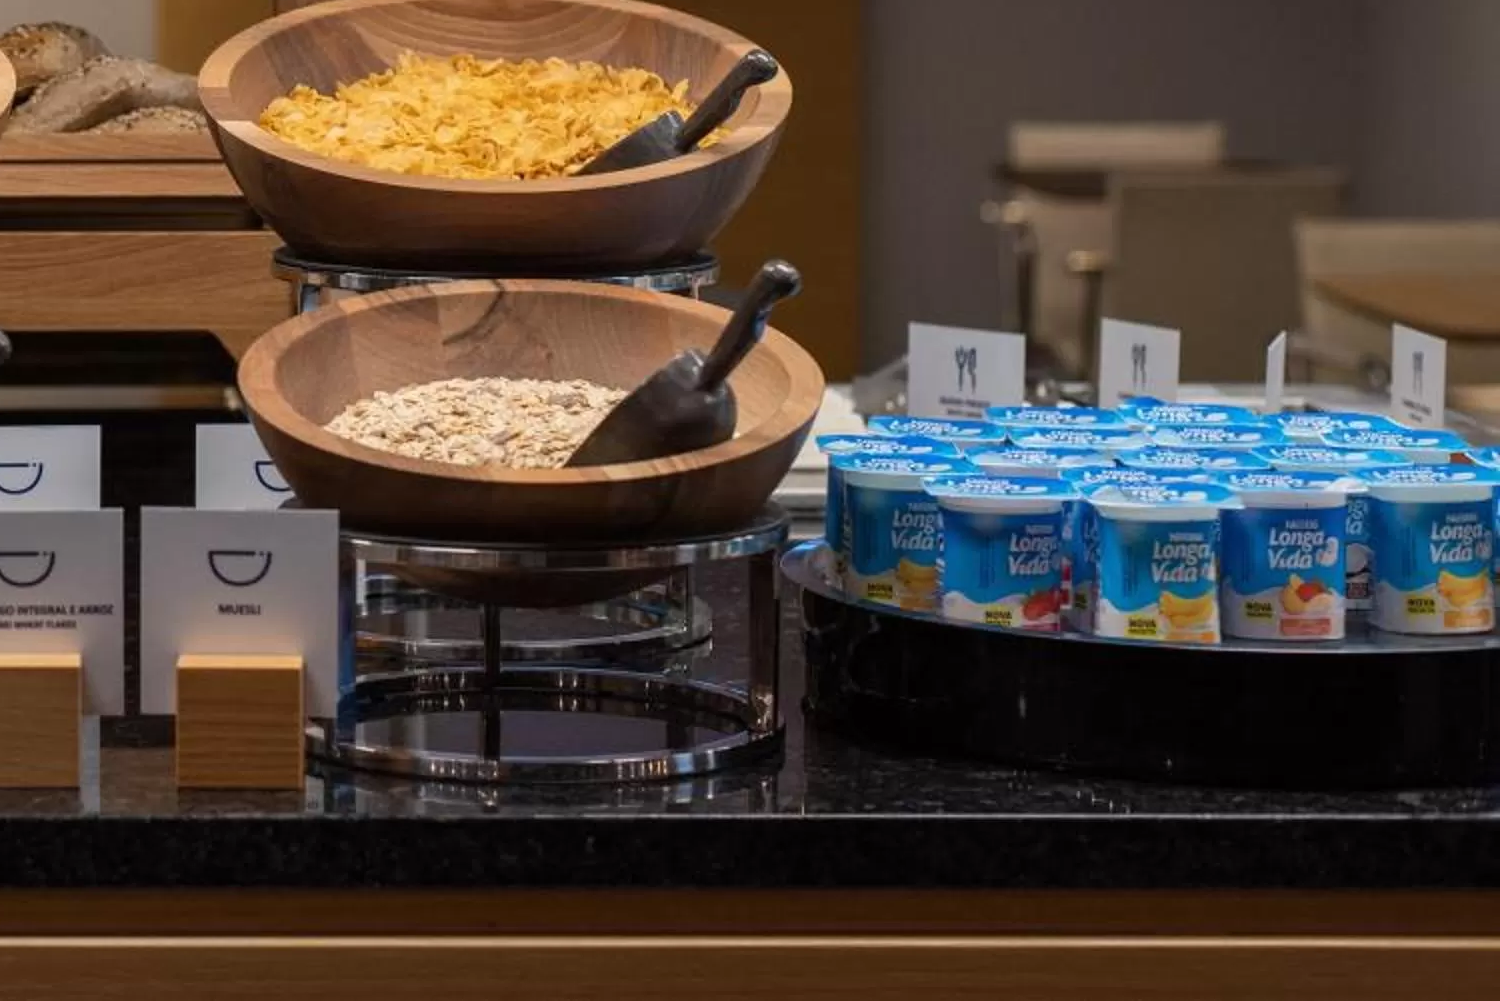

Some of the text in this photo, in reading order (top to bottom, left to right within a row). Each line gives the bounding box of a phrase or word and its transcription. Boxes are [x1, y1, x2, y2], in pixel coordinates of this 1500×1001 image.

[892, 507, 939, 534] Long
[1431, 520, 1483, 545] Longa
[1269, 527, 1324, 552] Longa
[1153, 539, 1209, 566] Longa
[1268, 548, 1312, 569] Vida
[1430, 542, 1472, 564] Vida
[1151, 561, 1198, 583] Vida
